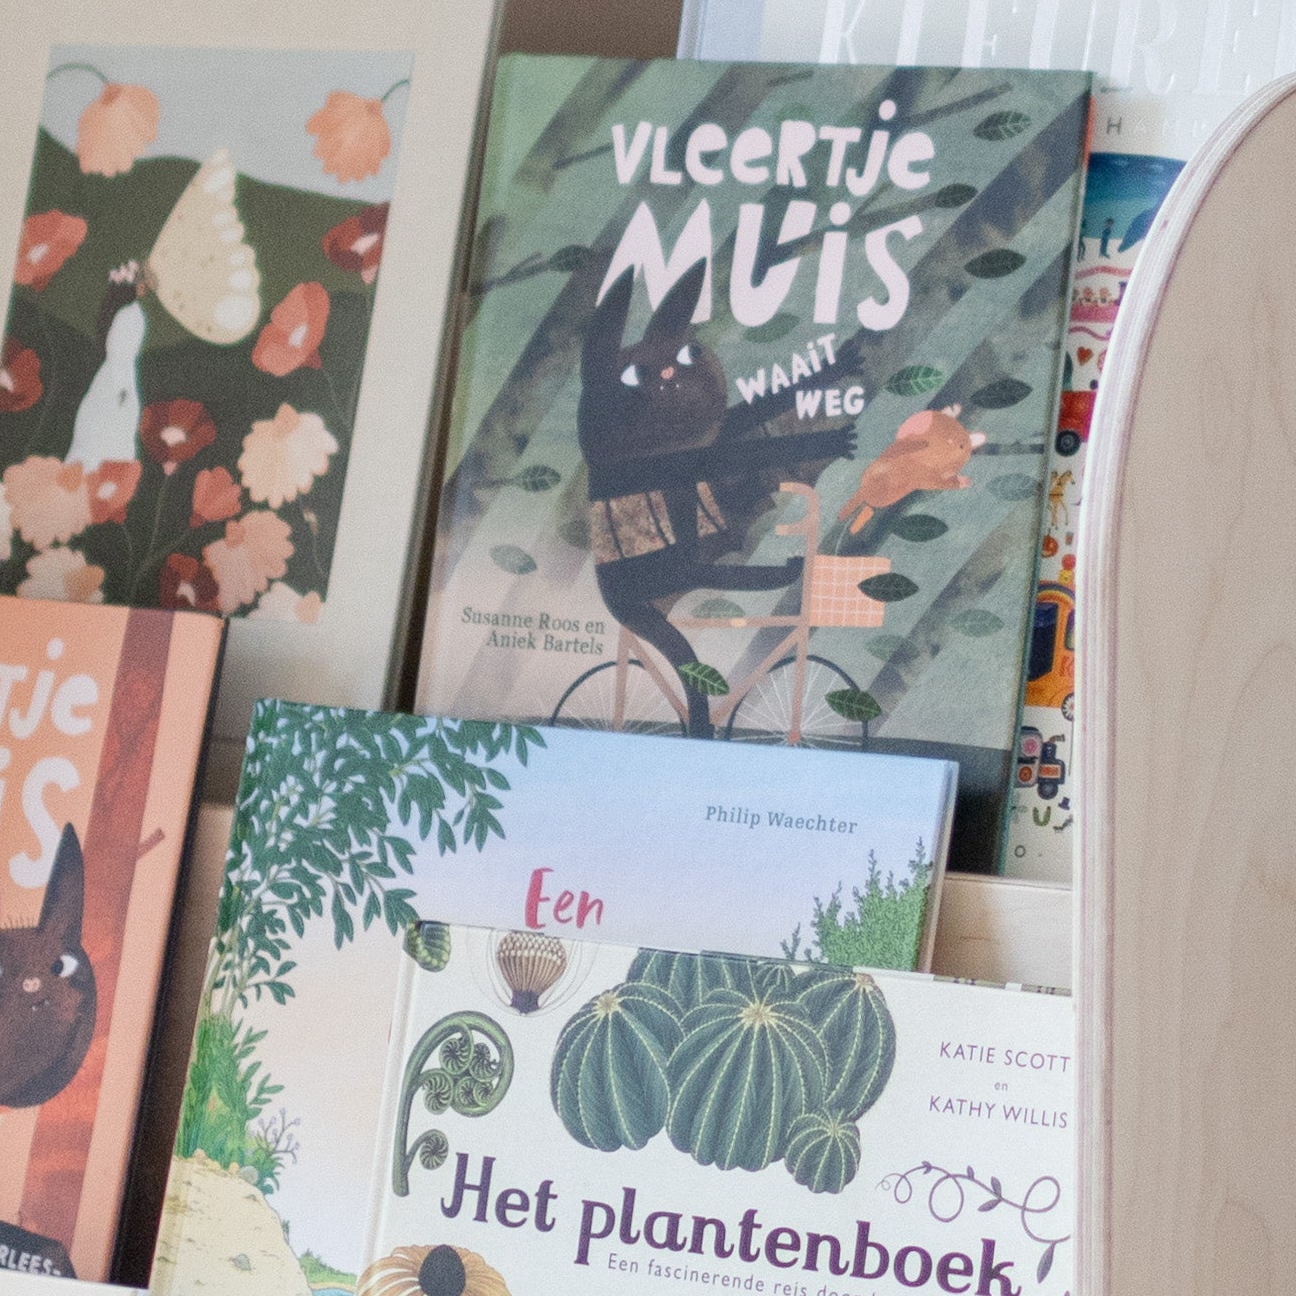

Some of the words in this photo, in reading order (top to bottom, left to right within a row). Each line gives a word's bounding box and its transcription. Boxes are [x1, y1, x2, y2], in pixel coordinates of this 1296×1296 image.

[794, 385, 865, 420] WEG
[461, 607, 533, 628] Susanne
[539, 611, 580, 631] Roos
[586, 621, 605, 636] en
[487, 630, 536, 649] Aniek
[544, 634, 604, 655] Bartels
[705, 804, 762, 831] Philip
[767, 807, 859, 837] Waechter
[524, 866, 604, 931] Een
[940, 1042, 995, 1064] KATIE
[1004, 1049, 1070, 1073] SCOTT
[994, 1081, 1009, 1092] en
[929, 1096, 995, 1119] KATHY
[1002, 1105, 1068, 1129] WILLIS
[440, 1152, 559, 1234] Het
[607, 1252, 640, 1276] Een
[646, 1257, 766, 1295] fascinerende
